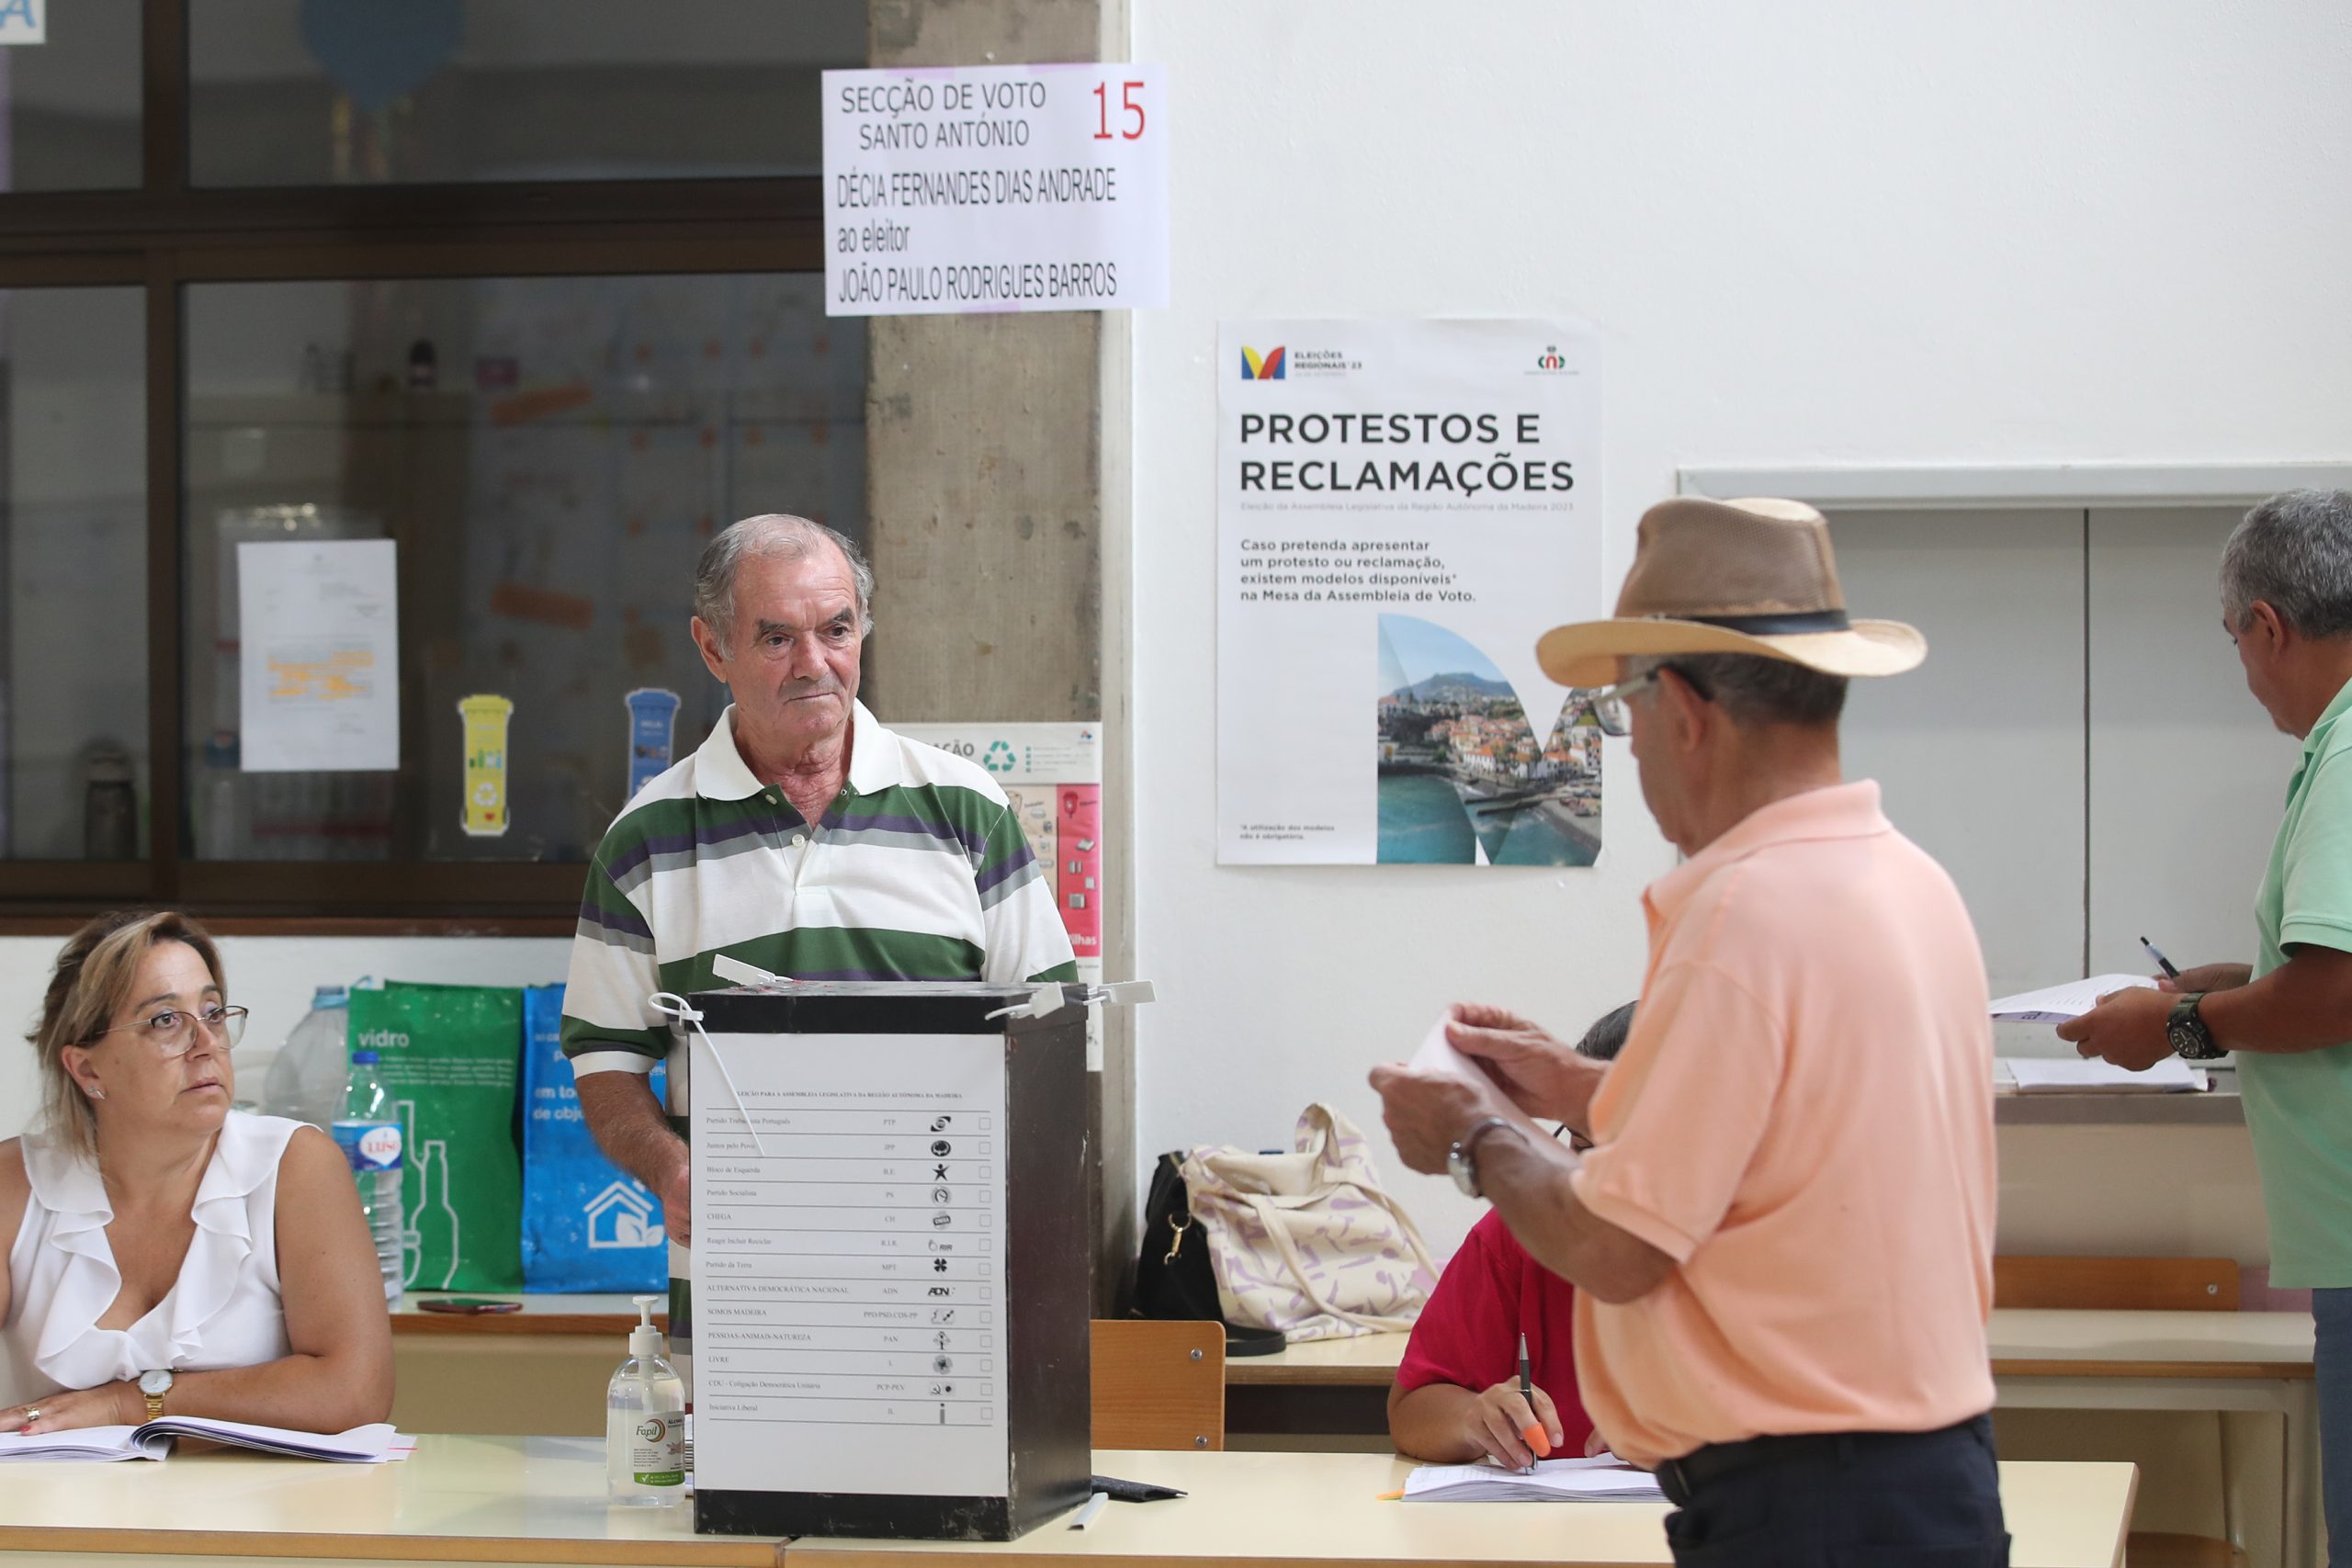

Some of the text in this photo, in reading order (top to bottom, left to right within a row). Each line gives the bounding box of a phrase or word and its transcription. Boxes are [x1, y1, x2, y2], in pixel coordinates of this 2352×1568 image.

[842, 77, 1046, 118] SECÇÃO DE VOTO
[1093, 81, 1145, 140] 15
[860, 112, 1029, 151] SANTO ANTÓNIO
[837, 166, 1116, 209] DÉCIA FERNANDES DIAS ANDRADE
[838, 219, 910, 253] ao eleitor
[839, 262, 1117, 303] JOÃO PAULO RODRIGUES BARROS
[1295, 350, 1343, 360] ELEIÇÕES
[1241, 413, 1540, 444] PROTESTOS E
[1241, 452, 1574, 497] RECLAMAÇÕES
[1240, 539, 1430, 554] Caso pretenda apresentar
[1240, 556, 1445, 570] um protesto ou reclamação,
[1240, 573, 1296, 584] existem
[1301, 573, 1364, 584] modelos
[1240, 590, 1476, 602] na Mesa da Assembleia de Voto.
[358, 1030, 410, 1049] vidro
[559, 1086, 577, 1099] to
[533, 1107, 551, 1119] de
[636, 1425, 658, 1438] Fapil
